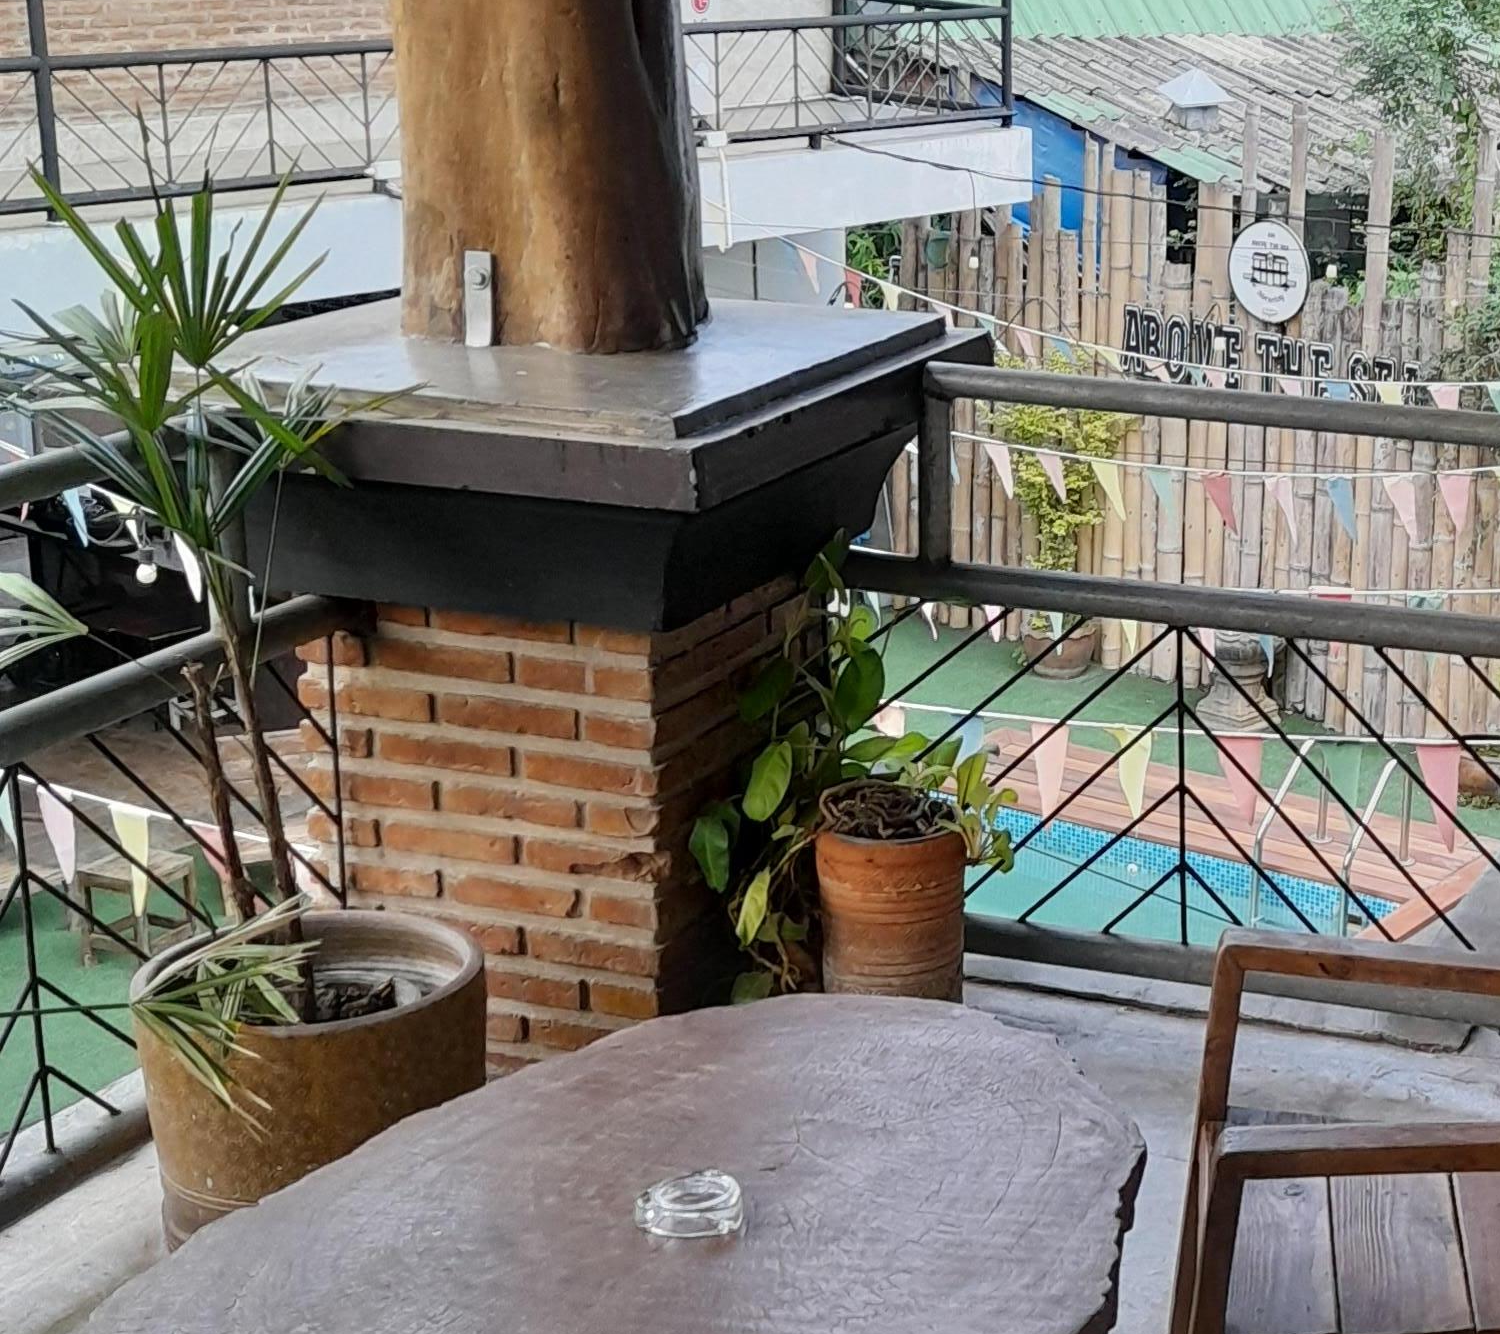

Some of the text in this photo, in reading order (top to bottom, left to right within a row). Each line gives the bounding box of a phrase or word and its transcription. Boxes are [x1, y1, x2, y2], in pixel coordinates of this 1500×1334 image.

[1121, 303, 1420, 405] ABOVE THE SEA
